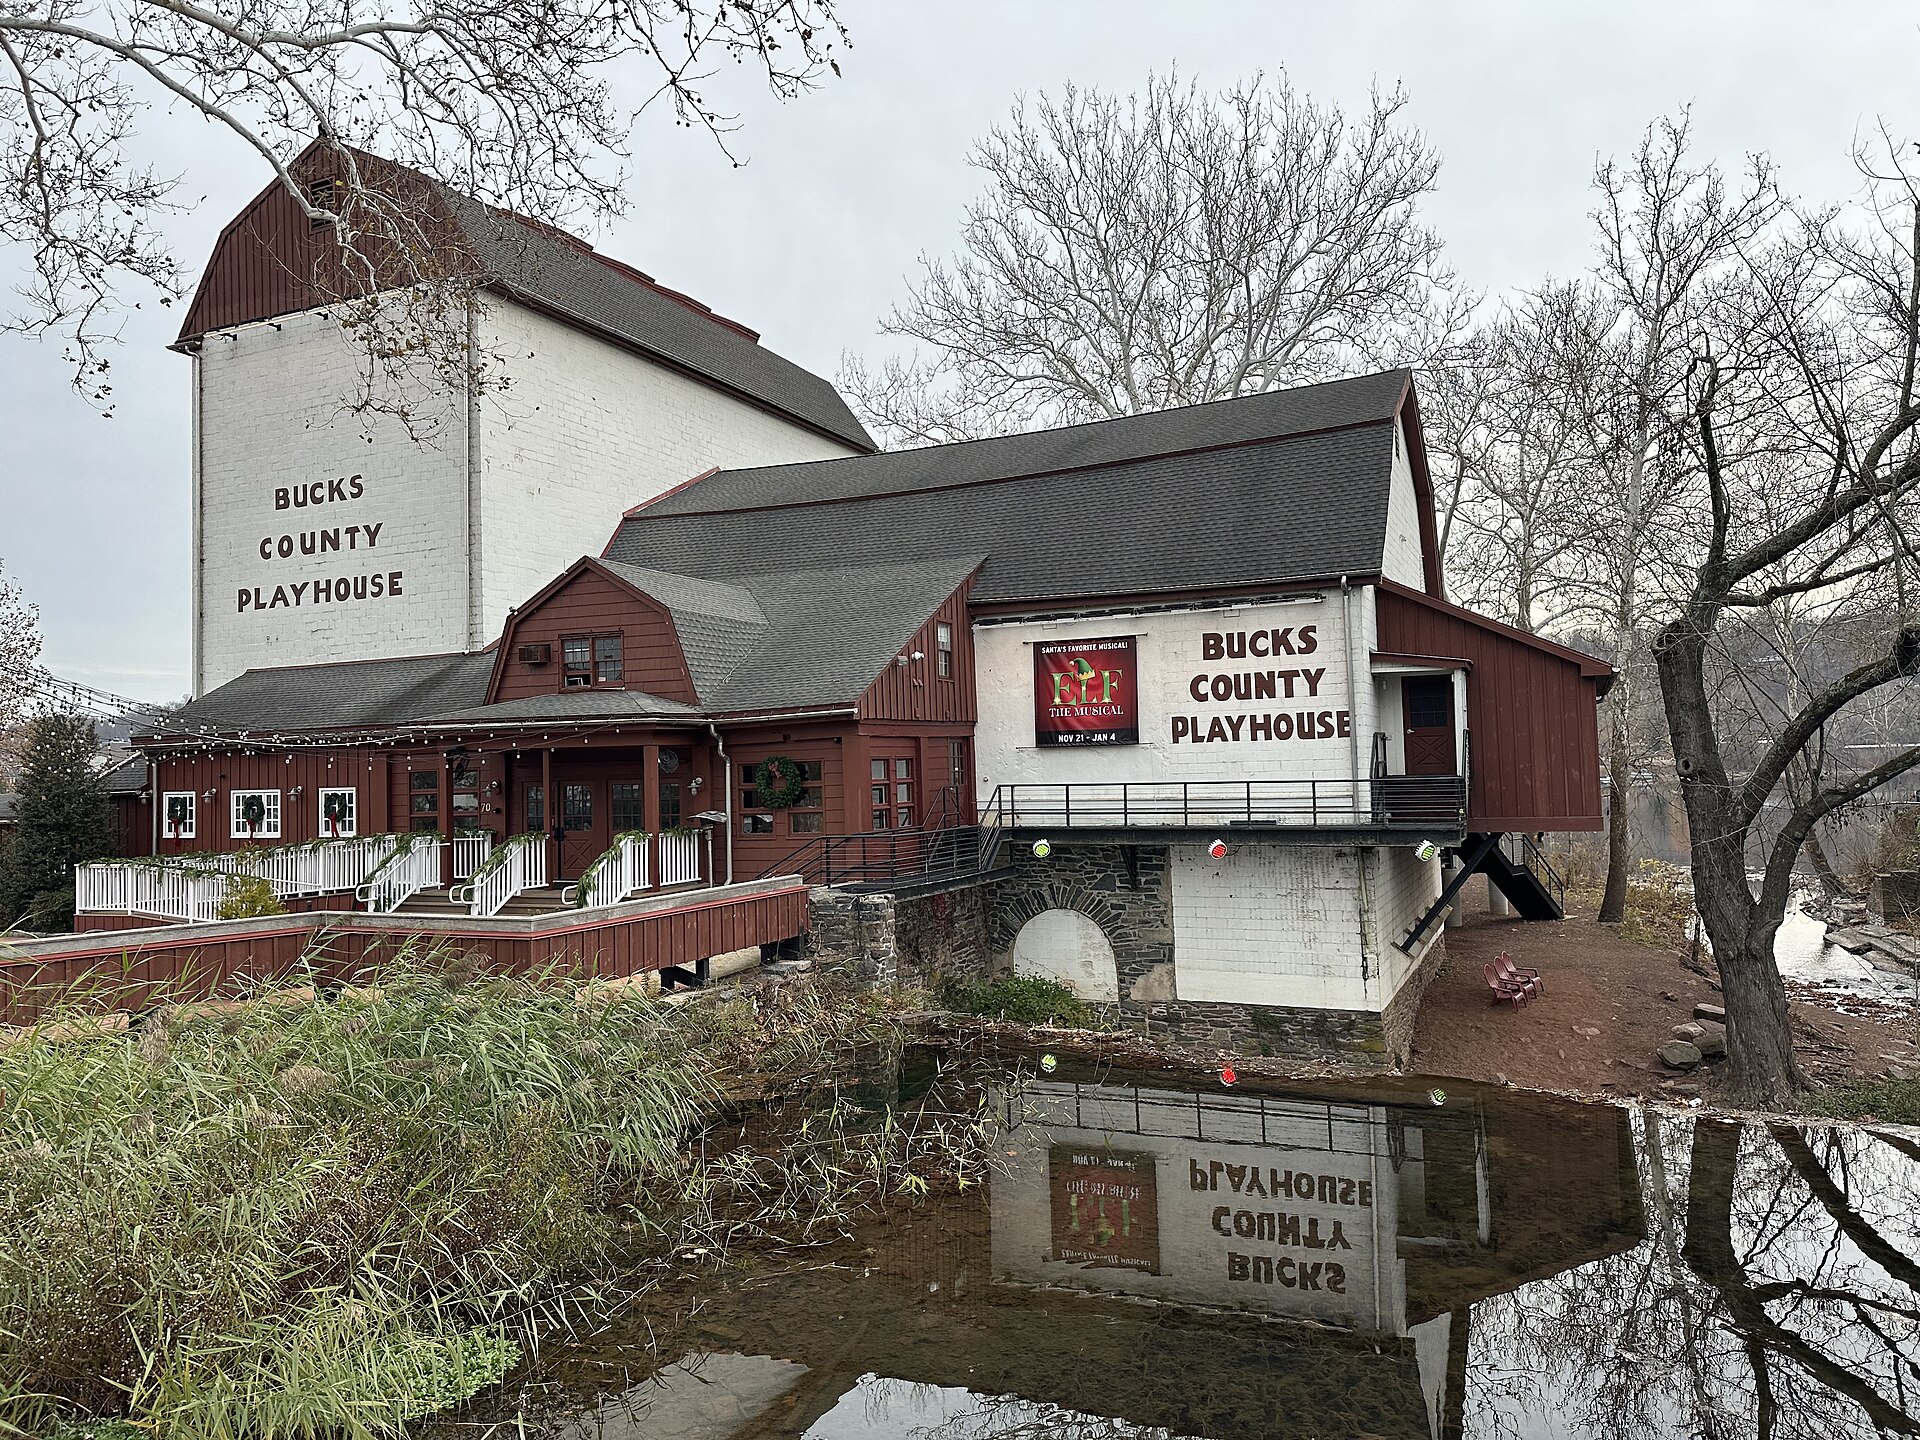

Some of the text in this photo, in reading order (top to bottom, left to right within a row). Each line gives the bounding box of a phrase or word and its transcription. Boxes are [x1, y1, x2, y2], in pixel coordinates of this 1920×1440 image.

[274, 474, 364, 510] BUCKS
[260, 522, 383, 560] COUNTY
[237, 571, 403, 612] PLAYHOUSE
[1042, 641, 1128, 654] SANTA'S FAVORITE MUSICAL!
[1202, 625, 1317, 660] BUCKS
[1050, 669, 1123, 706] ELF
[1190, 667, 1326, 702] COUNTY
[1049, 705, 1124, 718] THE MUSICAL
[1171, 710, 1350, 744] PLAYHOUSE
[1058, 734, 1074, 743] NOV
[1076, 734, 1084, 742] 21
[1092, 733, 1108, 742] JAN
[1110, 733, 1116, 741] 4
[480, 802, 491, 812] 70
